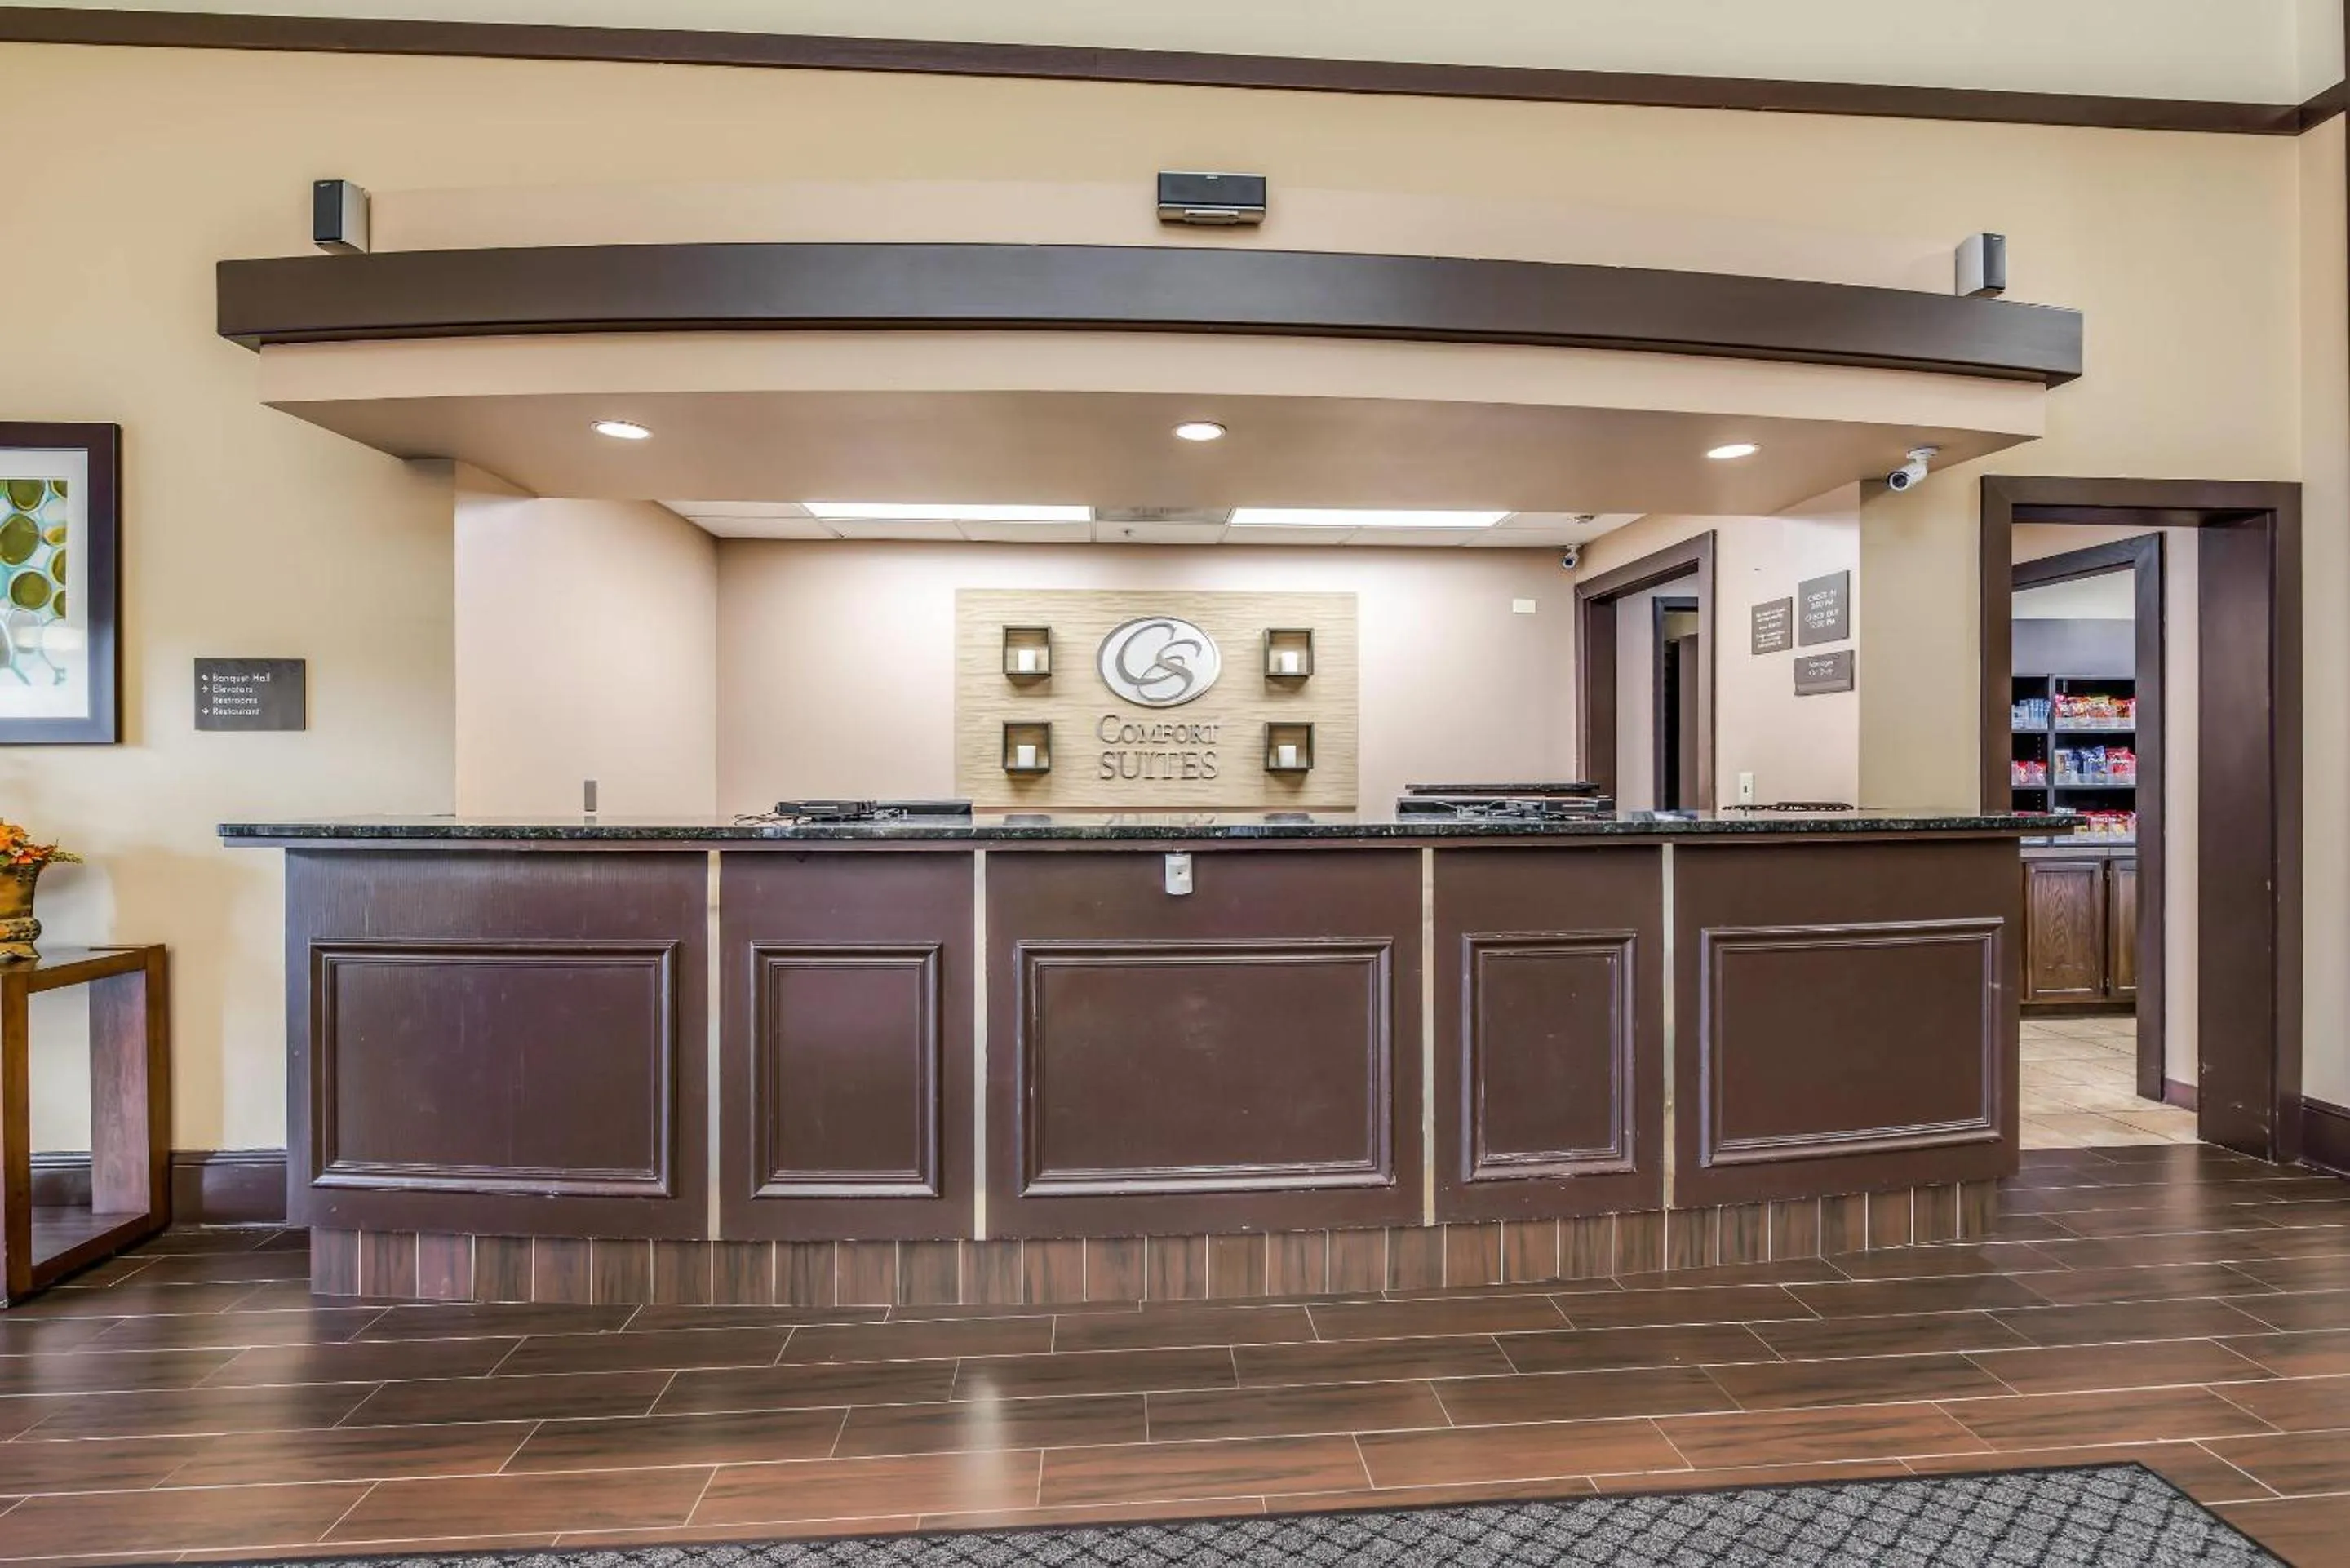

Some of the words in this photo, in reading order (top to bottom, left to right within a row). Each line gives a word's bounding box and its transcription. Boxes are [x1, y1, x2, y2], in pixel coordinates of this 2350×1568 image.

[212, 672, 250, 684] Banquet
[253, 672, 271, 682] Hall
[212, 684, 253, 693] Elevators
[212, 696, 258, 704] Restrooms
[212, 707, 260, 715] Restaurant
[1099, 751, 1219, 781] SUITES
